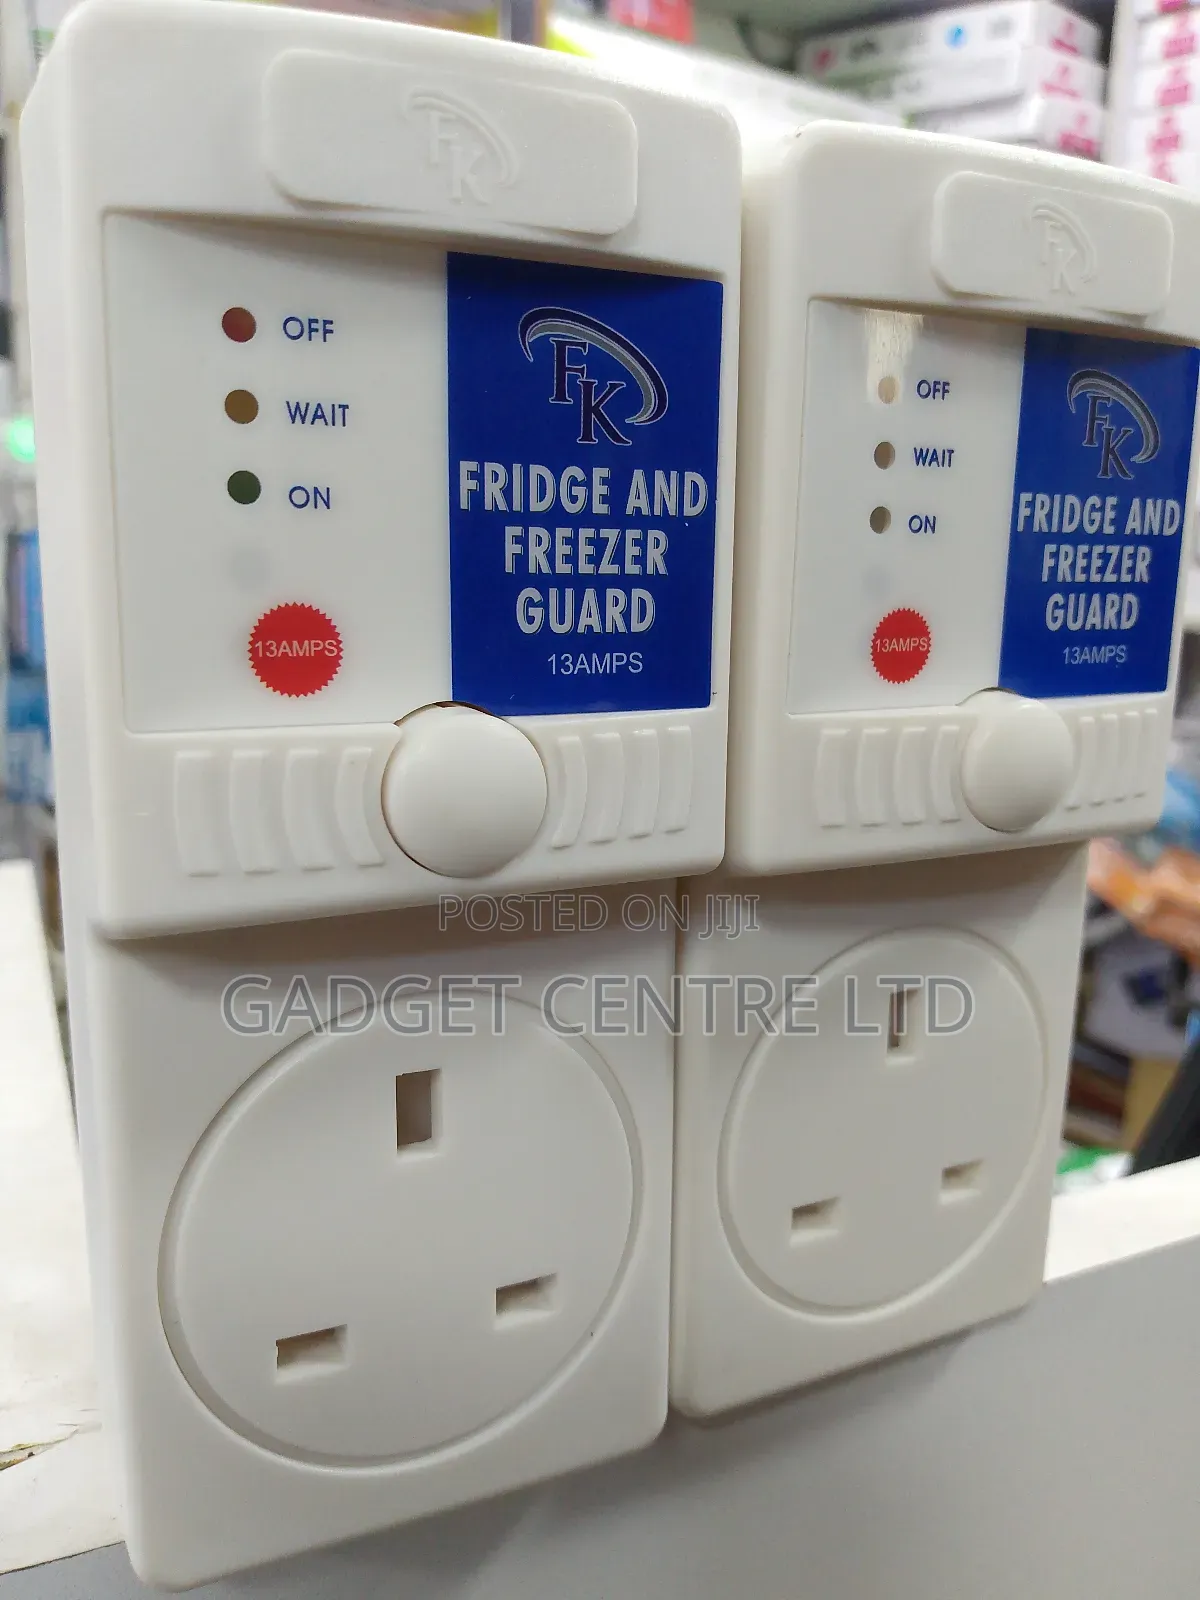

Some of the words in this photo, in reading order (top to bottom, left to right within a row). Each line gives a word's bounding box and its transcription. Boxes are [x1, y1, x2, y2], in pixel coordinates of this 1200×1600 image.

[282, 316, 335, 342] OFF
[549, 337, 632, 446] FK
[916, 379, 951, 401] OFF
[286, 401, 350, 427] WAIT
[1082, 395, 1135, 480] FK
[913, 447, 955, 468] WAIT
[288, 486, 331, 510] ON
[459, 460, 610, 515] FRIDGE
[626, 469, 708, 517] AND
[908, 514, 937, 535] ON
[1017, 492, 1118, 535] FRIDGE
[1125, 498, 1181, 536] AND
[504, 526, 669, 576] FREEZER
[1042, 544, 1151, 583] FREEZER
[516, 588, 656, 634] GUARD
[1045, 593, 1139, 631] GUARD
[255, 639, 339, 659] 13AMPS
[874, 637, 929, 654] 13AMPS
[1063, 645, 1127, 665] 13AMPS
[547, 653, 644, 676] 13AMPS
